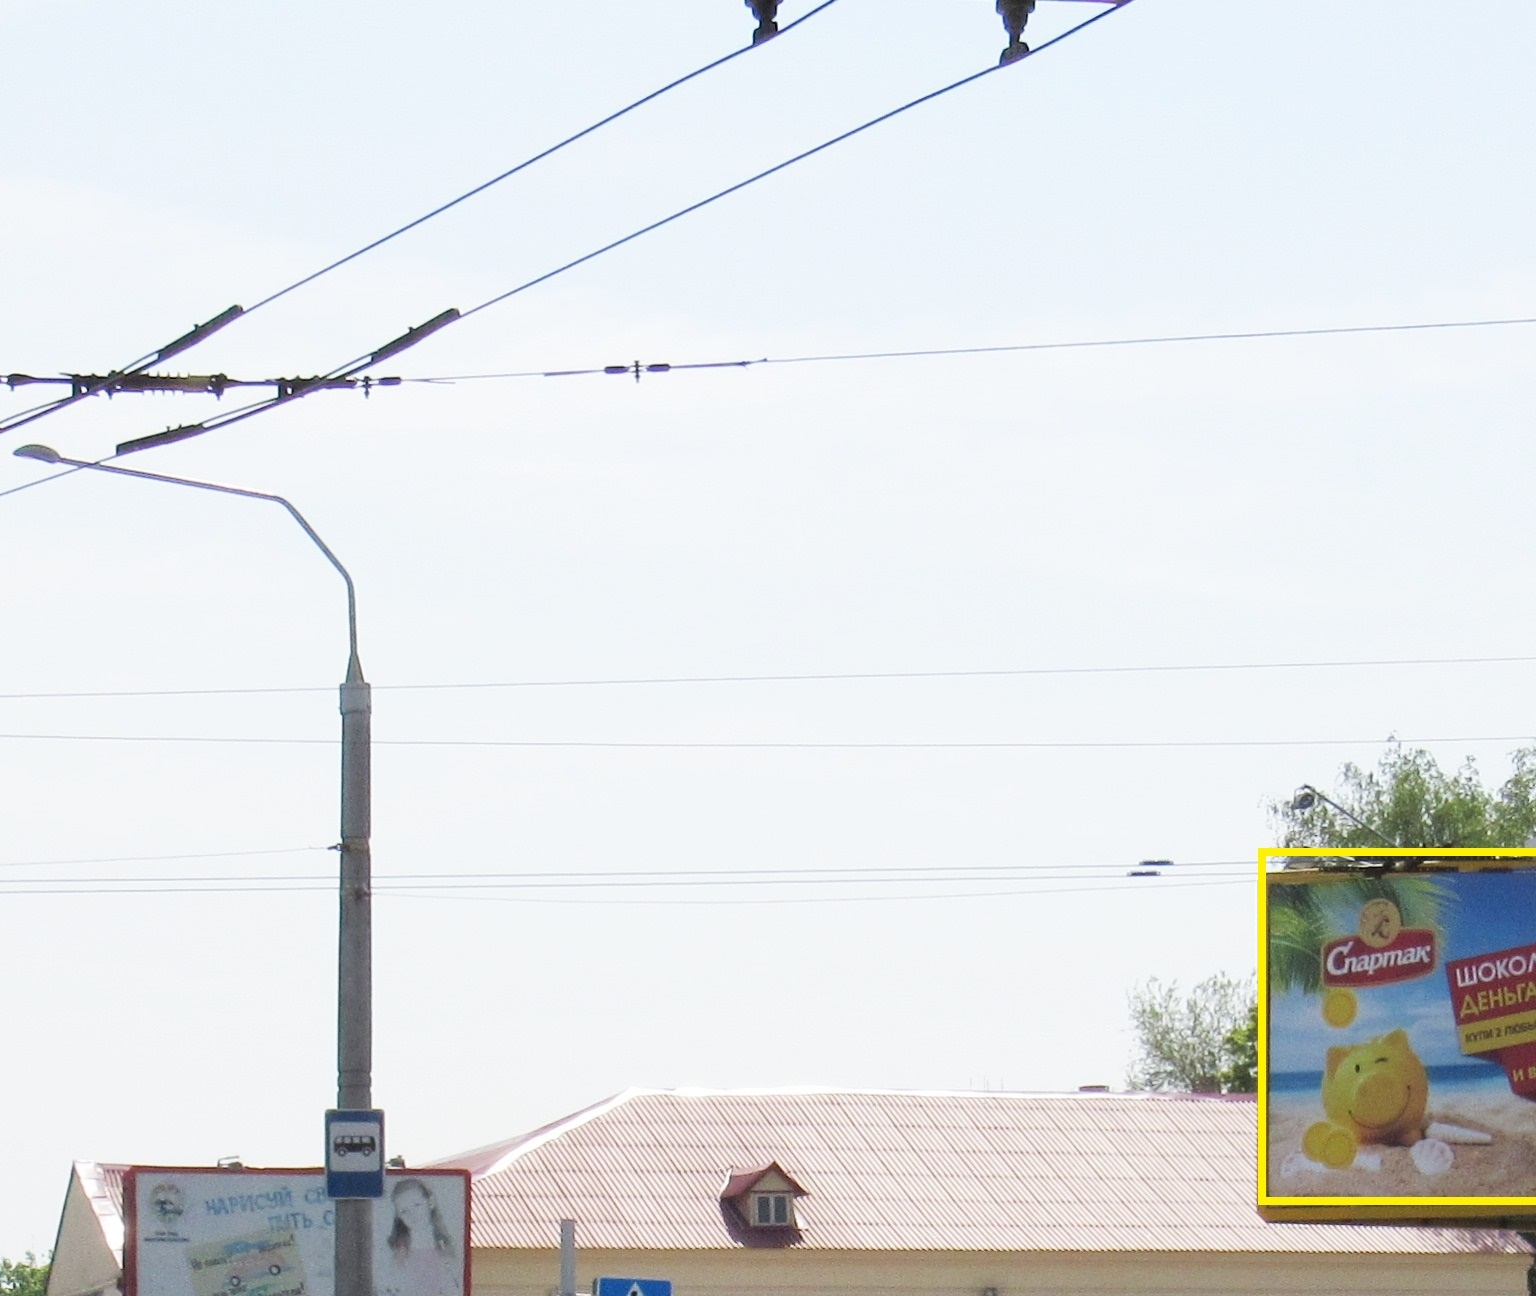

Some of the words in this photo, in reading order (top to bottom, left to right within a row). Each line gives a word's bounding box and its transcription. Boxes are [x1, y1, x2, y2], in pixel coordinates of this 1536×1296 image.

[1326, 941, 1431, 975] Спартак
[1495, 1030, 1502, 1038] 2
[1513, 1067, 1524, 1082] и
[206, 1186, 293, 1217] НАРИСУЙ
